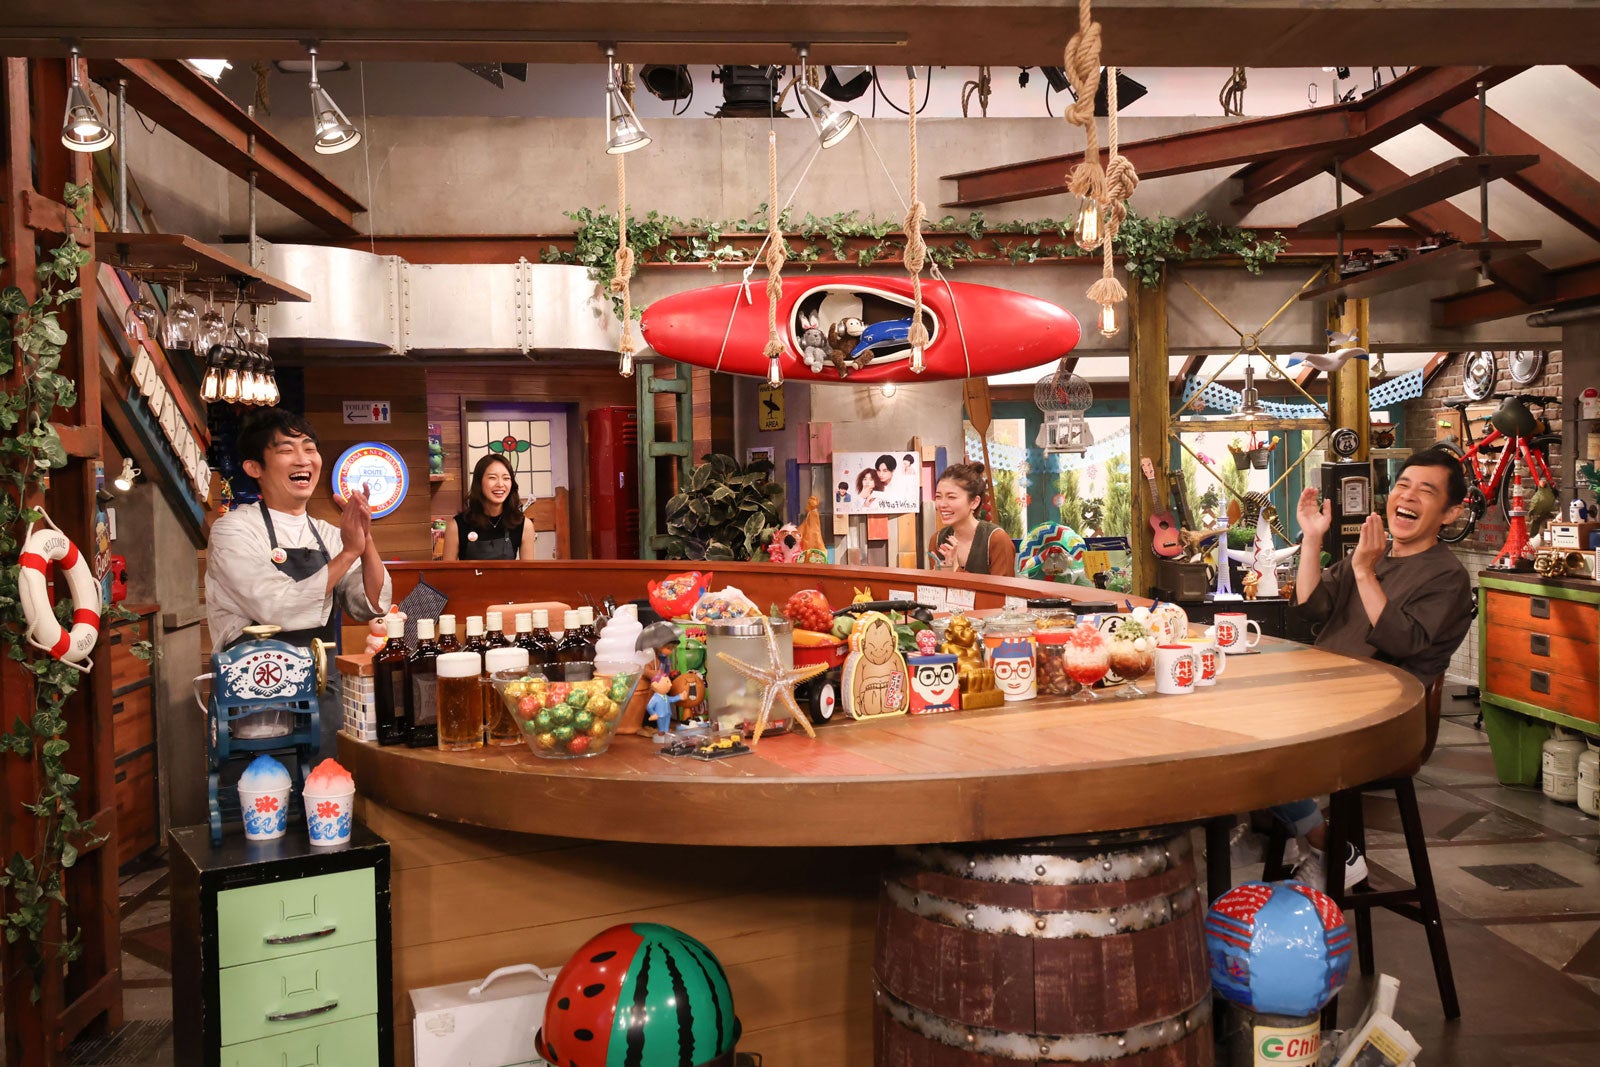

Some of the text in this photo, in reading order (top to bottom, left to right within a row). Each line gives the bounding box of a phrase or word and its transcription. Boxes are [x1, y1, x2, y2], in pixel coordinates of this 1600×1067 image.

[765, 420, 779, 428] AREA
[1343, 440, 1353, 450] 66
[341, 452, 362, 474] ARIZONA
[384, 454, 401, 476] MEXICO
[365, 478, 382, 492] 66
[376, 481, 401, 510] OKLAHOMA
[43, 537, 66, 554] WELCOME
[256, 663, 281, 686] 氷
[255, 795, 279, 813] 氷
[316, 800, 340, 819] 氷
